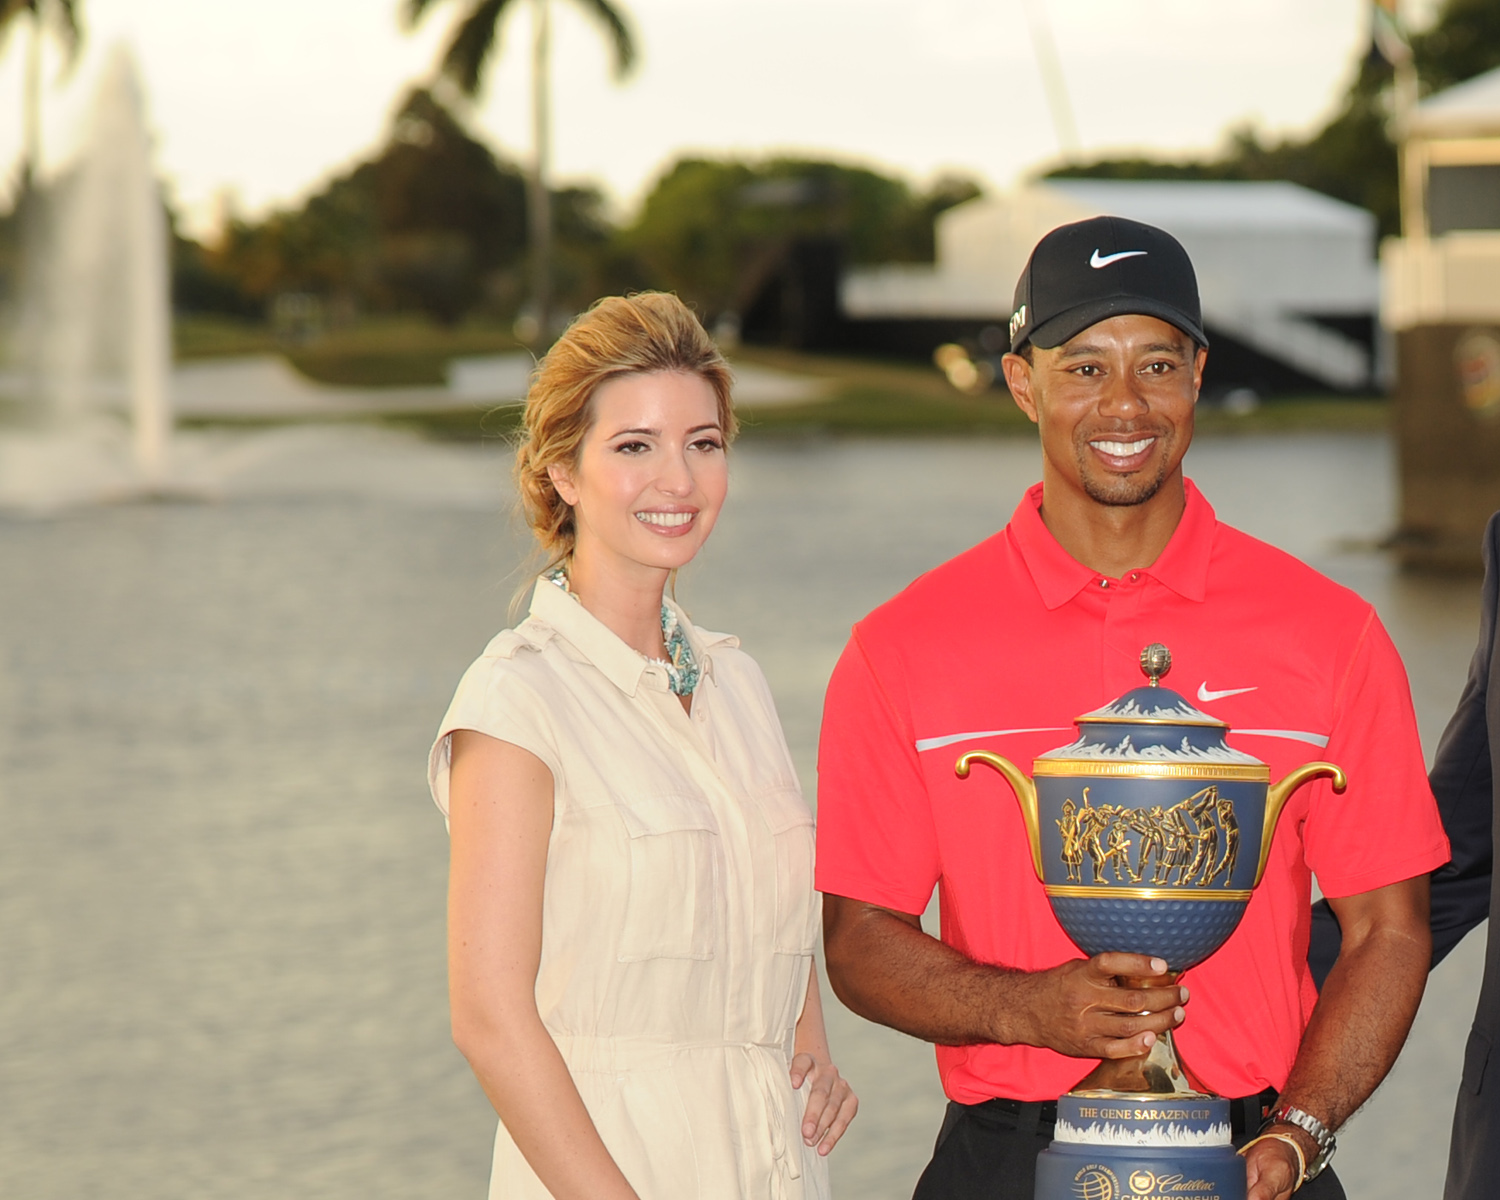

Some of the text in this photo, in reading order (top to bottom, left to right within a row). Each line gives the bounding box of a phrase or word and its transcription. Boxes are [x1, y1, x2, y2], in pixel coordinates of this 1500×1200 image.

[1079, 1107, 1211, 1120] THE GENE SARAZEN CUP
[1156, 1174, 1215, 1194] Cadillac
